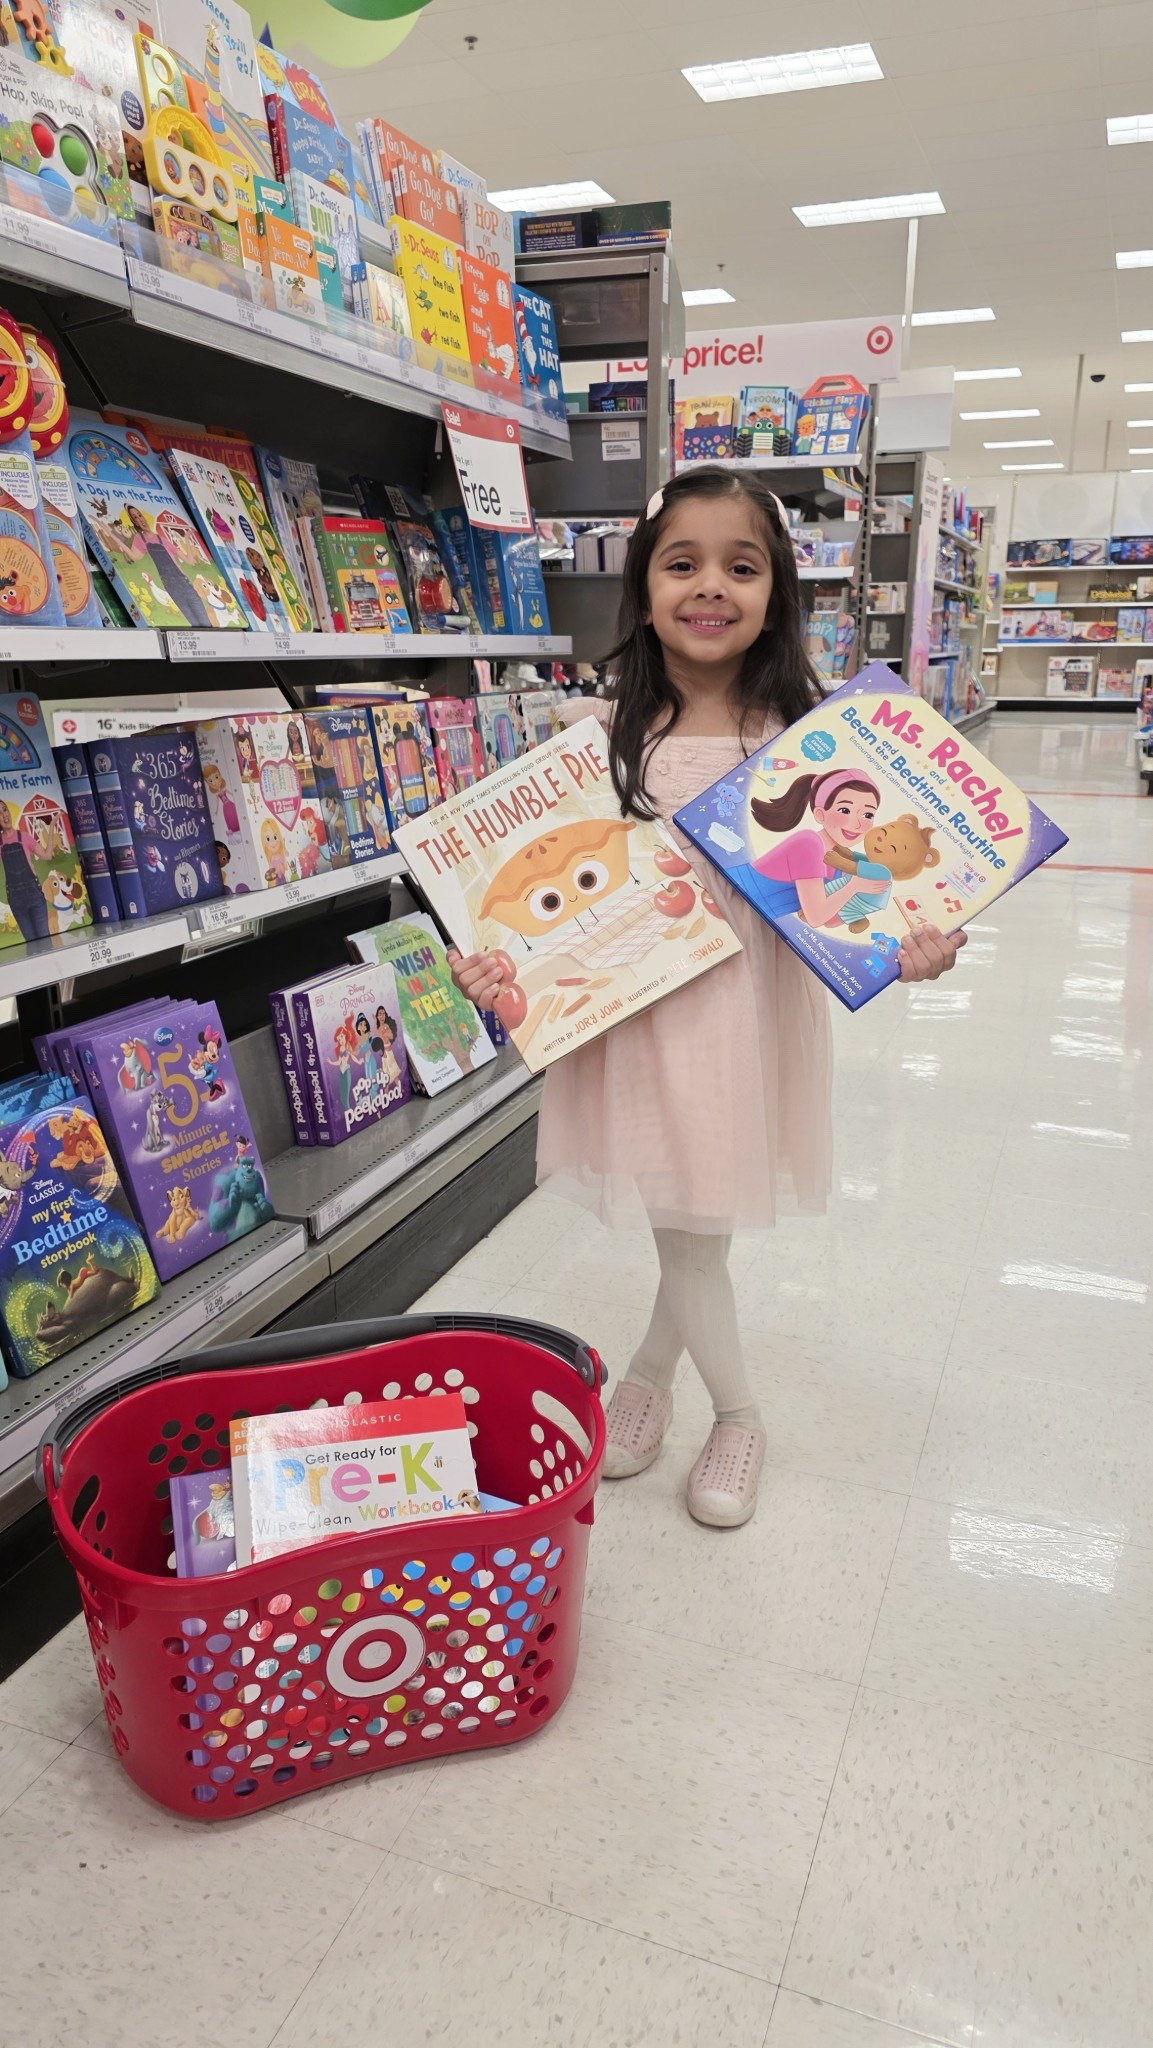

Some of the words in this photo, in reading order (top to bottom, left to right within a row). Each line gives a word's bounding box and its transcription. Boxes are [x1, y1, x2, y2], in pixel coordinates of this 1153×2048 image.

[236, 56, 254, 78] Go!
[0, 83, 28, 105] Hop,
[31, 90, 58, 113] Skip,
[60, 99, 84, 119] Pop!
[309, 185, 320, 202] Dr.
[420, 200, 435, 226] Go!
[474, 203, 499, 236] HOP
[4, 218, 29, 235] 11.99
[409, 234, 420, 252] Dr.
[420, 238, 440, 264] Seuss
[140, 272, 161, 287] 13.99
[464, 261, 485, 281] Green
[432, 276, 443, 290] One
[444, 281, 455, 294] fish
[473, 283, 490, 305] Eggs
[238, 308, 255, 322] 12.99
[438, 307, 449, 319] two
[449, 310, 461, 323] fish
[470, 305, 484, 318] and
[518, 294, 533, 310] THE
[531, 297, 551, 320] CAT
[472, 321, 489, 338] Ham
[541, 323, 549, 334] IN
[441, 336, 451, 347] red
[450, 337, 462, 350] fish
[540, 335, 553, 349] THE
[538, 347, 559, 372] HAT
[683, 334, 764, 375] price!
[445, 408, 461, 427] Sale!
[1, 471, 30, 479] INCLUDES
[194, 461, 230, 488] Picnic
[77, 482, 91, 495] A
[92, 482, 110, 502] Day
[113, 488, 124, 498] on
[127, 488, 147, 501] the
[149, 491, 177, 506] Farm
[205, 483, 238, 507] Time!
[459, 469, 502, 516] Free
[179, 641, 197, 650] 13.99
[275, 641, 290, 650] 14.99
[22, 702, 33, 713] 12
[840, 706, 878, 746] Bean
[875, 744, 890, 762] the
[881, 740, 900, 756] and
[146, 750, 178, 779] 365
[870, 699, 924, 749] Ms.
[927, 736, 1024, 843] Rachel
[0, 777, 21, 790] the
[22, 774, 53, 788] Farm
[429, 819, 440, 827] THE
[450, 808, 462, 817] NEW
[462, 798, 476, 810] YORK
[476, 789, 492, 801] TIMES
[491, 772, 521, 792] BESTSELLING
[521, 763, 535, 774] FOOD
[535, 752, 553, 766] GROUP
[553, 741, 570, 755] SERIES
[929, 769, 948, 786] and
[147, 784, 196, 815] Bedtime
[272, 801, 283, 813] 12
[416, 826, 471, 875] THE
[464, 767, 568, 849] HUMBLE
[560, 742, 609, 790] PIE
[849, 735, 883, 772] Encouraging
[880, 769, 887, 777] a
[885, 772, 901, 789] Calm
[899, 786, 913, 800] and
[910, 797, 943, 831] Comforting
[942, 826, 957, 843] Good
[954, 841, 975, 860] Night
[889, 755, 951, 816] Bedtime
[948, 811, 1007, 870] Routine
[158, 811, 200, 842] Stories
[350, 837, 374, 850] Bedtime
[354, 846, 375, 859] Stories
[964, 861, 975, 873] Only
[286, 889, 300, 900] 13.99
[211, 911, 228, 923] 16.99
[90, 948, 112, 962] 20.99
[391, 945, 437, 978] WISH
[795, 932, 816, 955] illustrated
[813, 951, 821, 962] by
[820, 957, 843, 984] Monique
[840, 980, 856, 997] Dong
[803, 927, 810, 936] by
[808, 932, 818, 944] Ms.
[817, 939, 835, 961] Rachel
[832, 957, 843, 970] and
[840, 966, 852, 979] Mr.
[849, 975, 863, 991] Aron
[346, 984, 366, 996] Disney
[407, 976, 425, 996] IN
[425, 971, 440, 990] A
[542, 1036, 566, 1053] WRITTEN
[566, 1031, 574, 1039] BY
[574, 1016, 599, 1035] JORY
[599, 998, 624, 1020] JOHN
[626, 980, 660, 1003] ILLUSTRATED
[660, 974, 668, 984] BY
[666, 958, 689, 978] PETE
[688, 937, 724, 964] OSWALD
[410, 986, 455, 1021] TREE
[155, 1031, 174, 1042] Disney
[157, 1042, 200, 1127] 5
[344, 1079, 403, 1133] peekaboo!
[171, 1121, 214, 1150] Minute
[161, 1131, 231, 1174] SNUGGLE
[182, 1156, 222, 1184] Stories
[28, 1182, 65, 1206] CLASSICS
[31, 1179, 54, 1192] Disney
[31, 1210, 50, 1225] my
[50, 1195, 75, 1217] first
[11, 1206, 109, 1266] Bedtime
[40, 1232, 98, 1270] storybook
[204, 1295, 225, 1316] 12.99
[310, 1413, 402, 1432] SCHOLASTIC
[305, 1453, 330, 1465] Get
[335, 1447, 376, 1465] Ready
[379, 1446, 397, 1457] for
[273, 1441, 443, 1512] Pre-K
[358, 1495, 454, 1522] Workbook
[256, 1511, 352, 1538] Wipe-Clean
